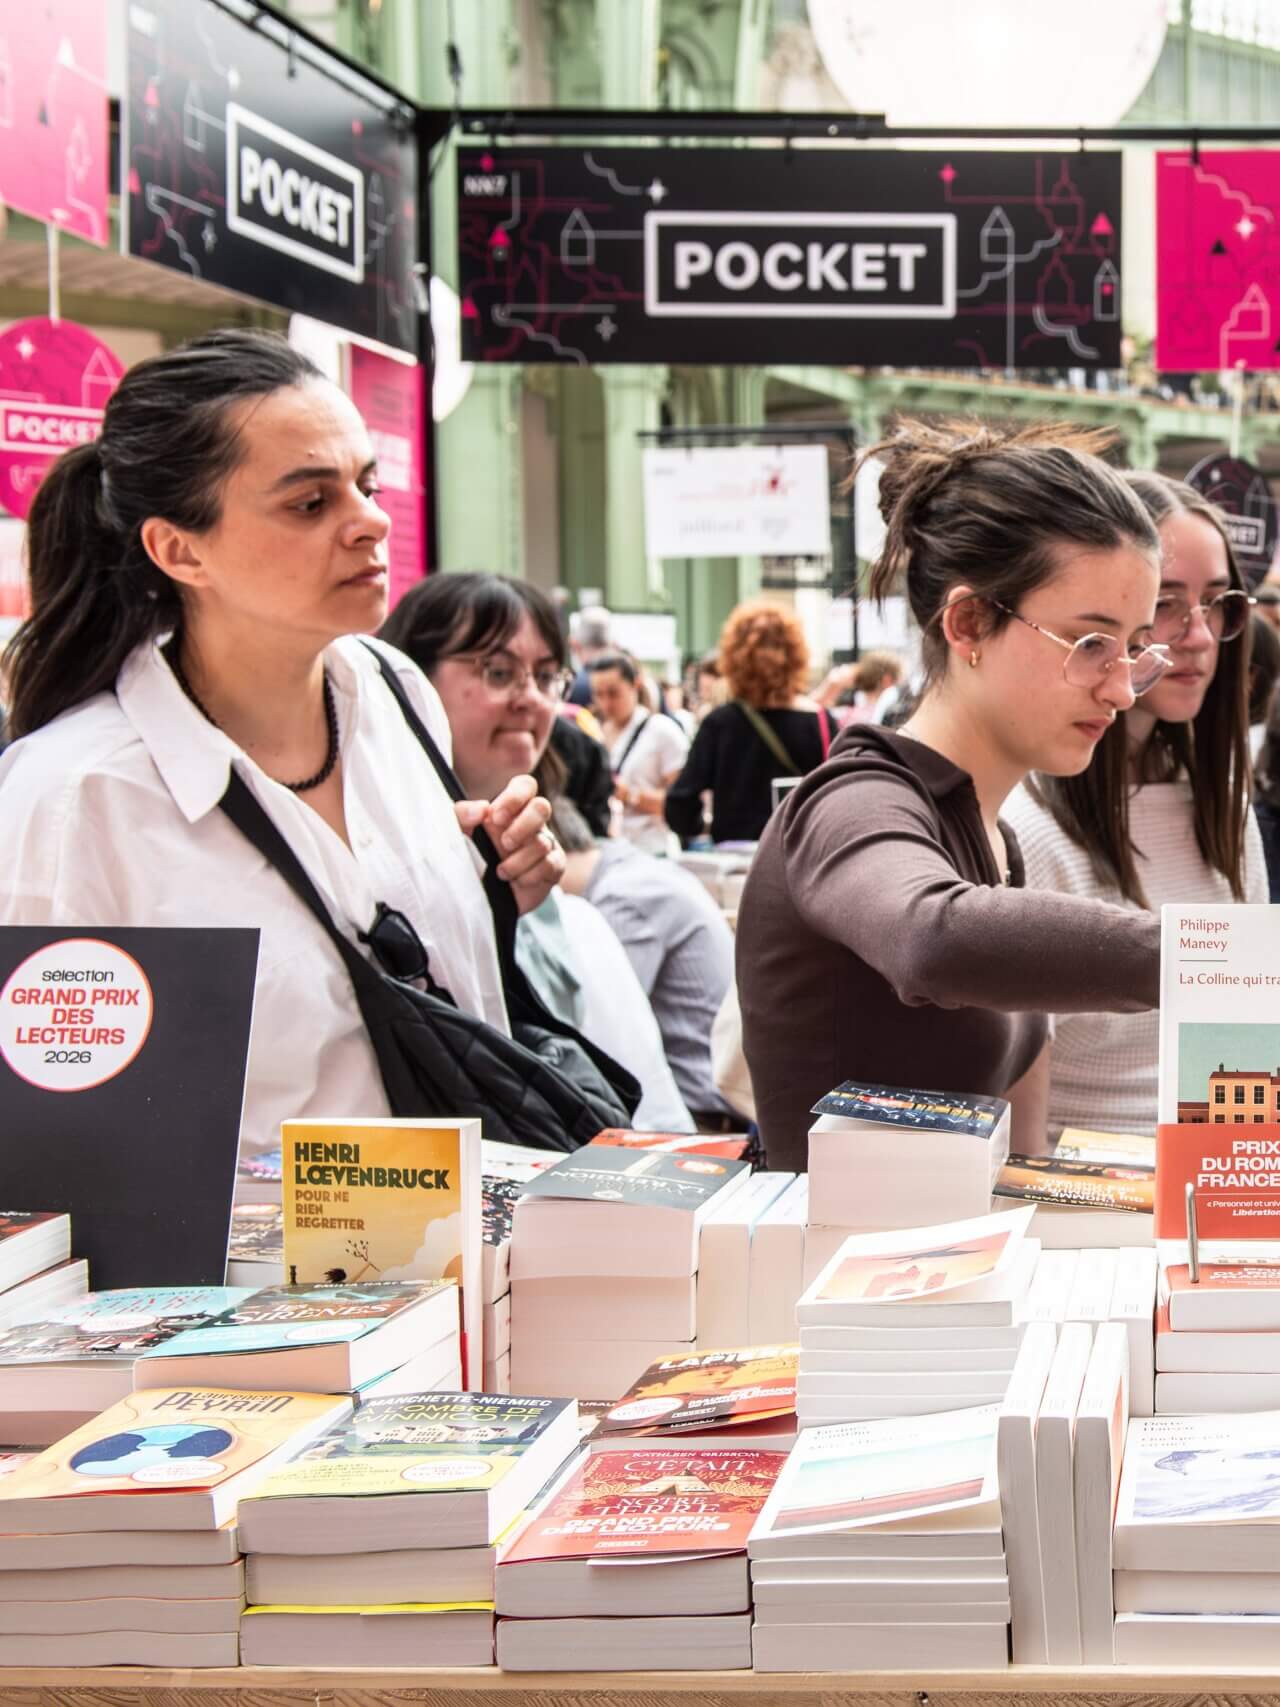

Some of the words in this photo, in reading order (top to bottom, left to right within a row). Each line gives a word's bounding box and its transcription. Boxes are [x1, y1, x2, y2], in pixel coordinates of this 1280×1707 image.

[240, 145, 353, 249] POCKET
[674, 241, 927, 292] POCKET
[1179, 917, 1231, 934] Philippe
[1179, 937, 1229, 953] Manevy
[41, 968, 115, 983] sélection
[1179, 972, 1194, 986] La
[1196, 972, 1241, 986] Colline
[1242, 973, 1263, 988] qui
[10, 988, 87, 1006] GRAND
[90, 988, 141, 1006] PRIX
[51, 1008, 95, 1025] DES
[15, 1027, 126, 1045] LECTEURS
[44, 1050, 92, 1064] 2026
[294, 1142, 360, 1164] HENRI
[1201, 1157, 1234, 1171] DU
[294, 1164, 450, 1190] LŒVENBRUCK
[295, 1190, 331, 1202] POUR
[334, 1190, 350, 1203] NE
[295, 1203, 324, 1216] RIEN
[295, 1217, 365, 1231] REGRETTER
[383, 1404, 501, 1415] L'OMBRE
[506, 1407, 546, 1415] DE
[352, 1412, 540, 1424] WINNICOTT
[616, 1496, 709, 1506] NOTRE
[594, 1503, 721, 1516] TERRE
[563, 1517, 656, 1529] GRAND
[659, 1515, 722, 1527] PRIX
